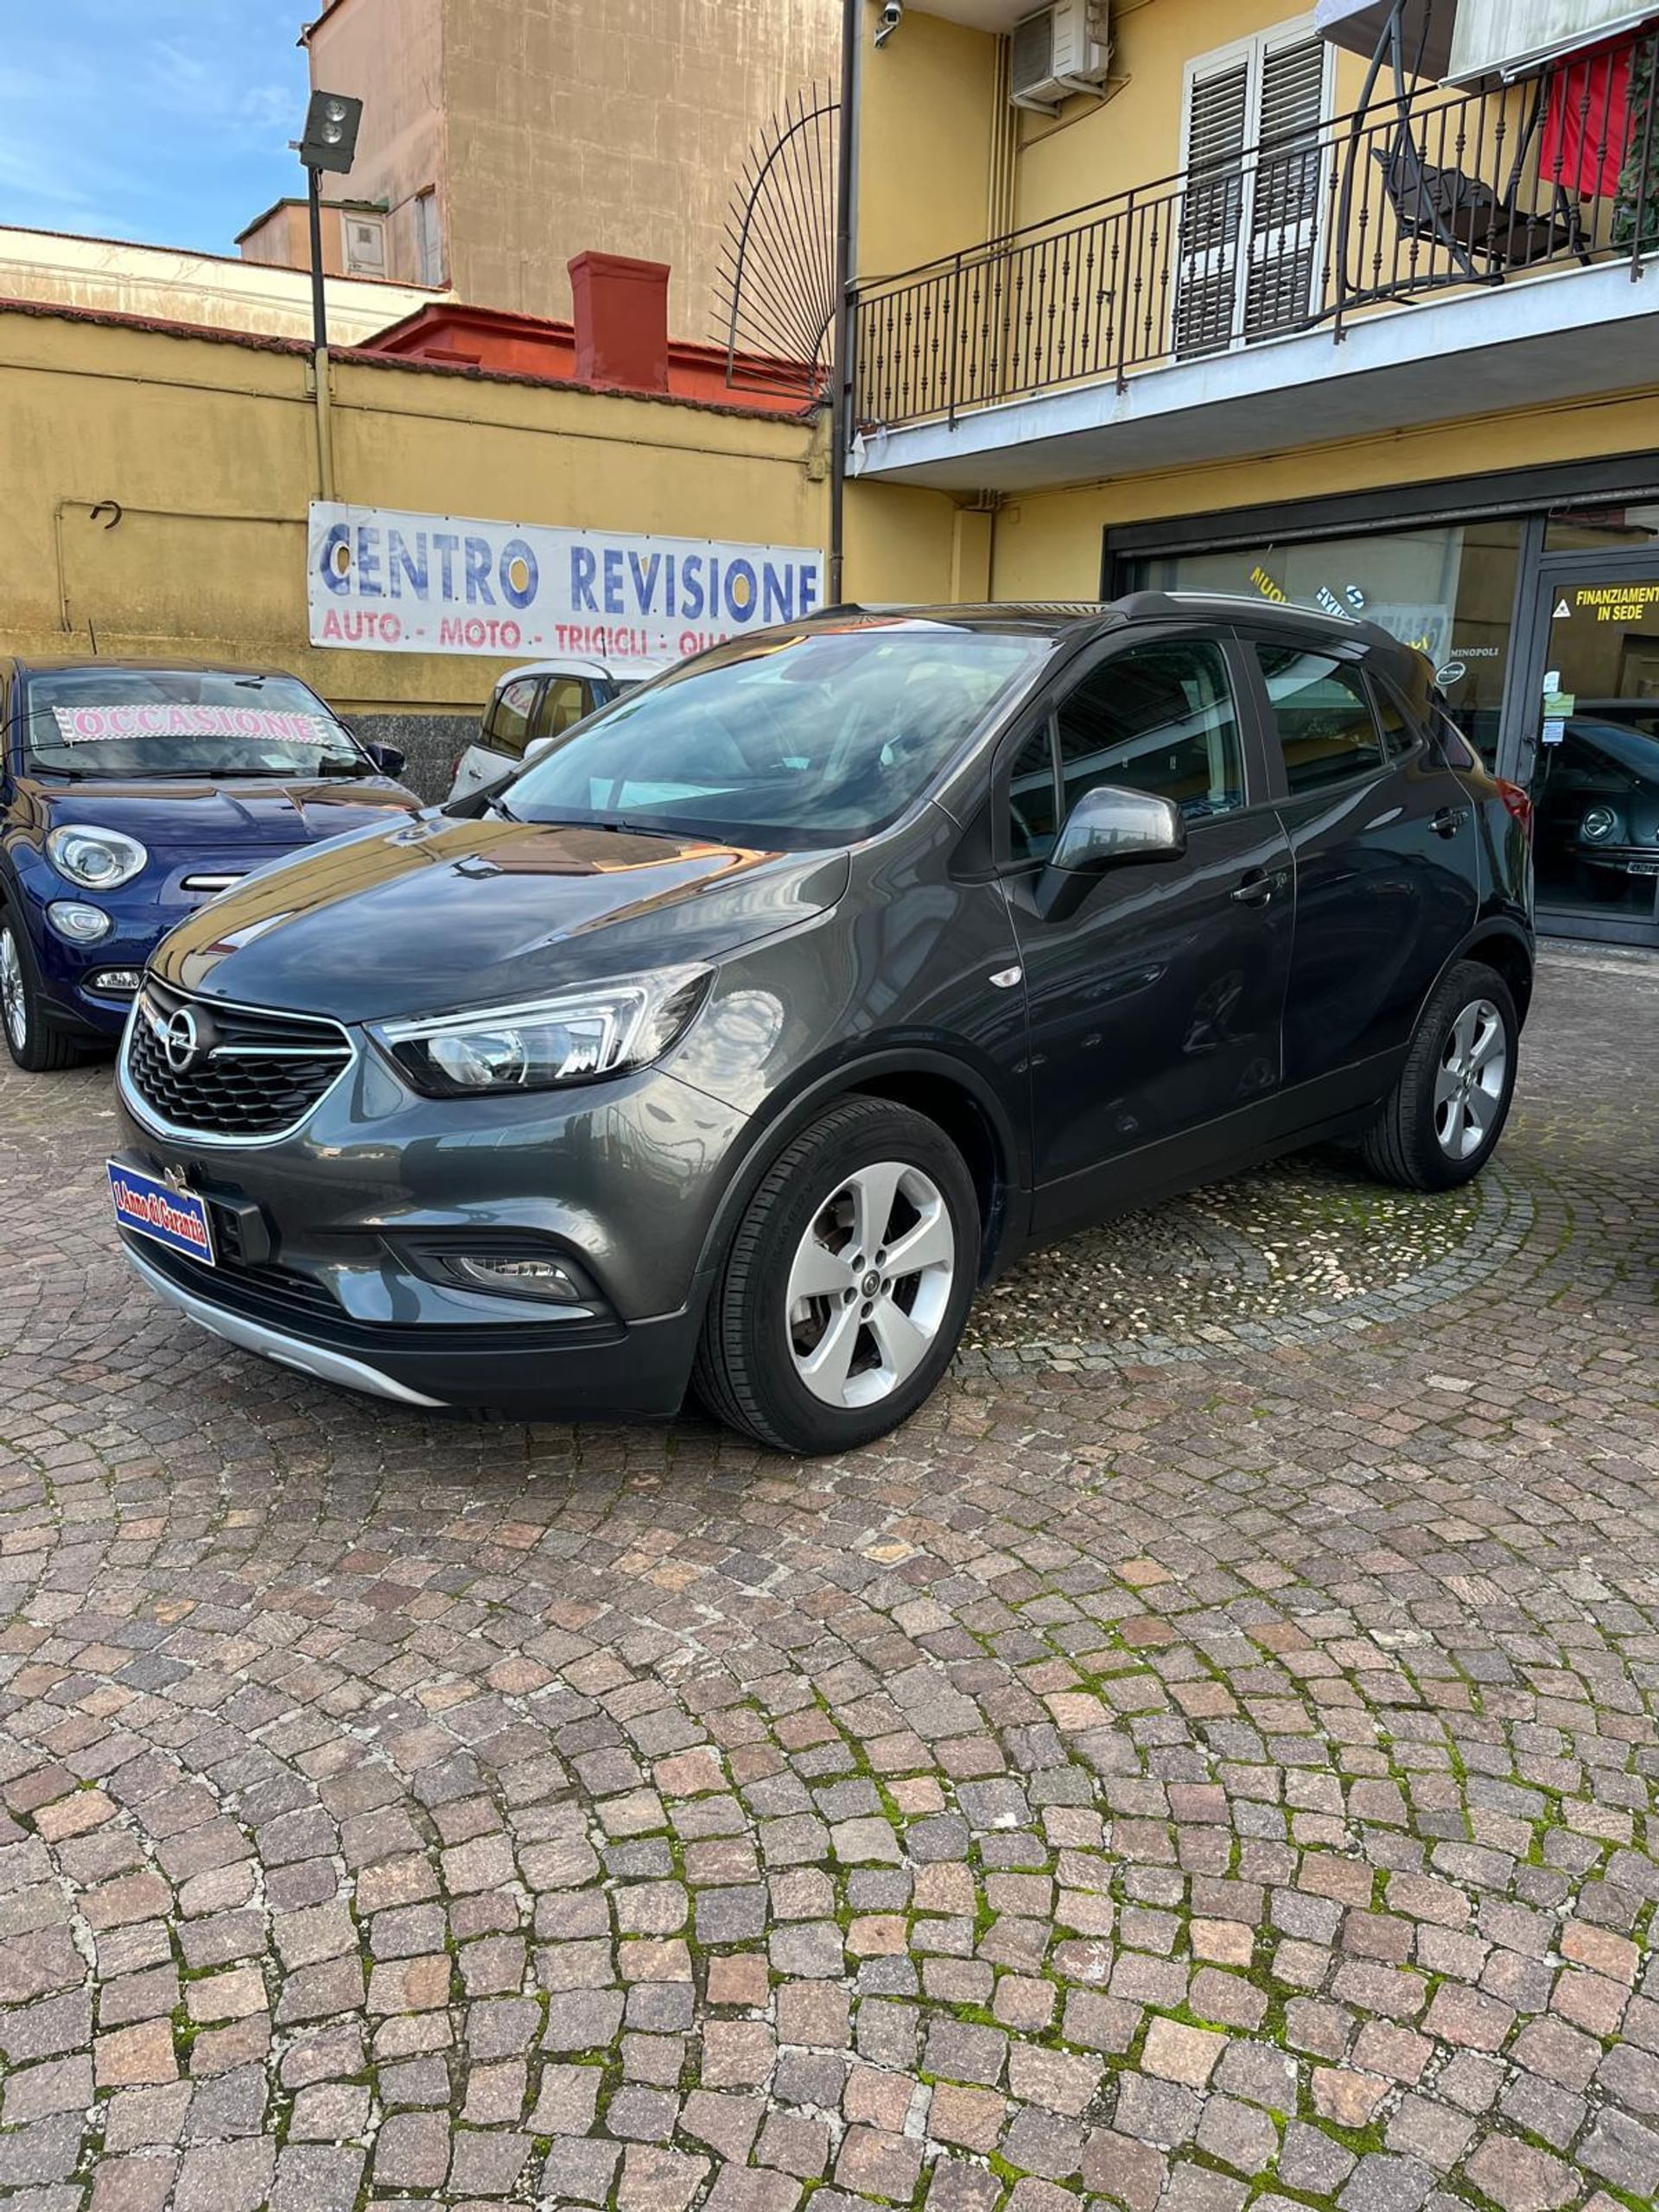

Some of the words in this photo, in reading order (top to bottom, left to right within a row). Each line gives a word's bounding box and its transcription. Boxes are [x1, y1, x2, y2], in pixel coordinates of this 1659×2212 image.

[321, 523, 538, 609] CENTRO
[570, 545, 817, 623] REVISIONE
[1598, 607, 1611, 620] IN
[1612, 605, 1643, 620] SEDE
[322, 608, 401, 643] AUTO
[440, 617, 521, 649] MOTO
[555, 624, 647, 656] TRICICLI
[1450, 648, 1498, 658] MINOPOLI
[75, 709, 313, 738] OCCASIONE
[121, 1180, 149, 1222] Anno
[148, 1193, 162, 1227] di
[159, 1197, 207, 1248] Garanzia
